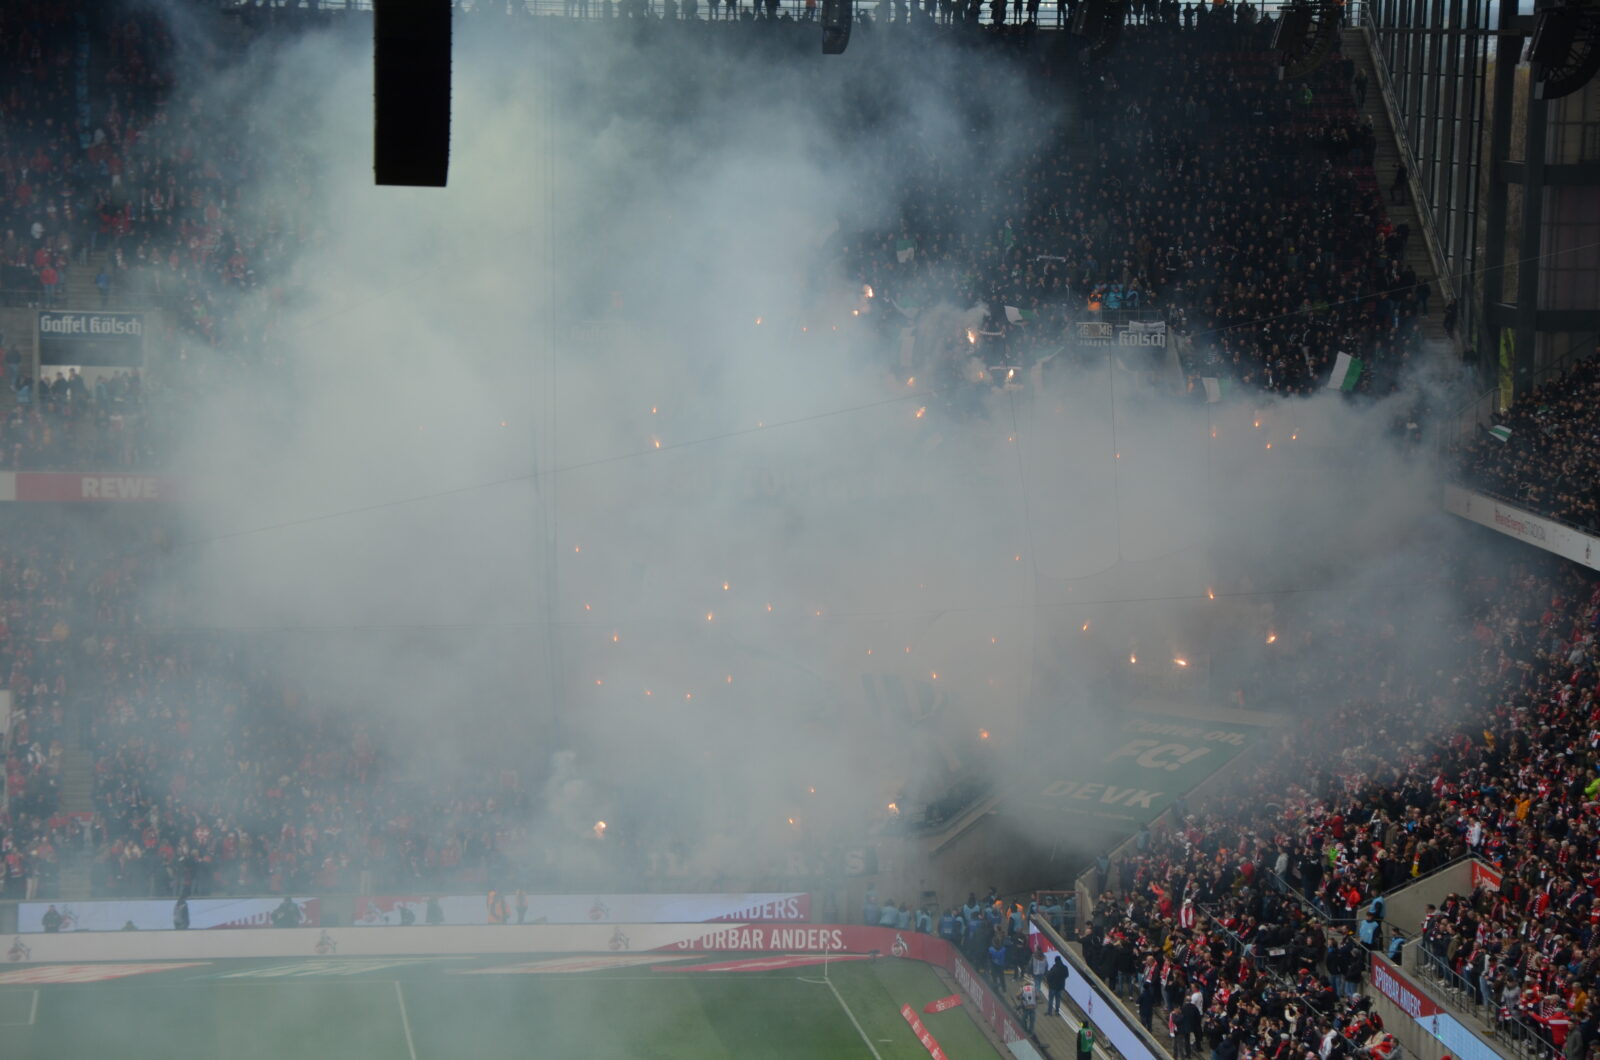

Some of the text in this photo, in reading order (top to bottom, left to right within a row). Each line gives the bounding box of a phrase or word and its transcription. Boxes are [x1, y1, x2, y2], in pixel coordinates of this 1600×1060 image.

[40, 315, 142, 336] Gaffel Kölsch
[81, 477, 160, 498] REWE
[1103, 739, 1212, 772] FC!
[1040, 780, 1165, 808] DEVK
[769, 929, 848, 950] ANDERS.
